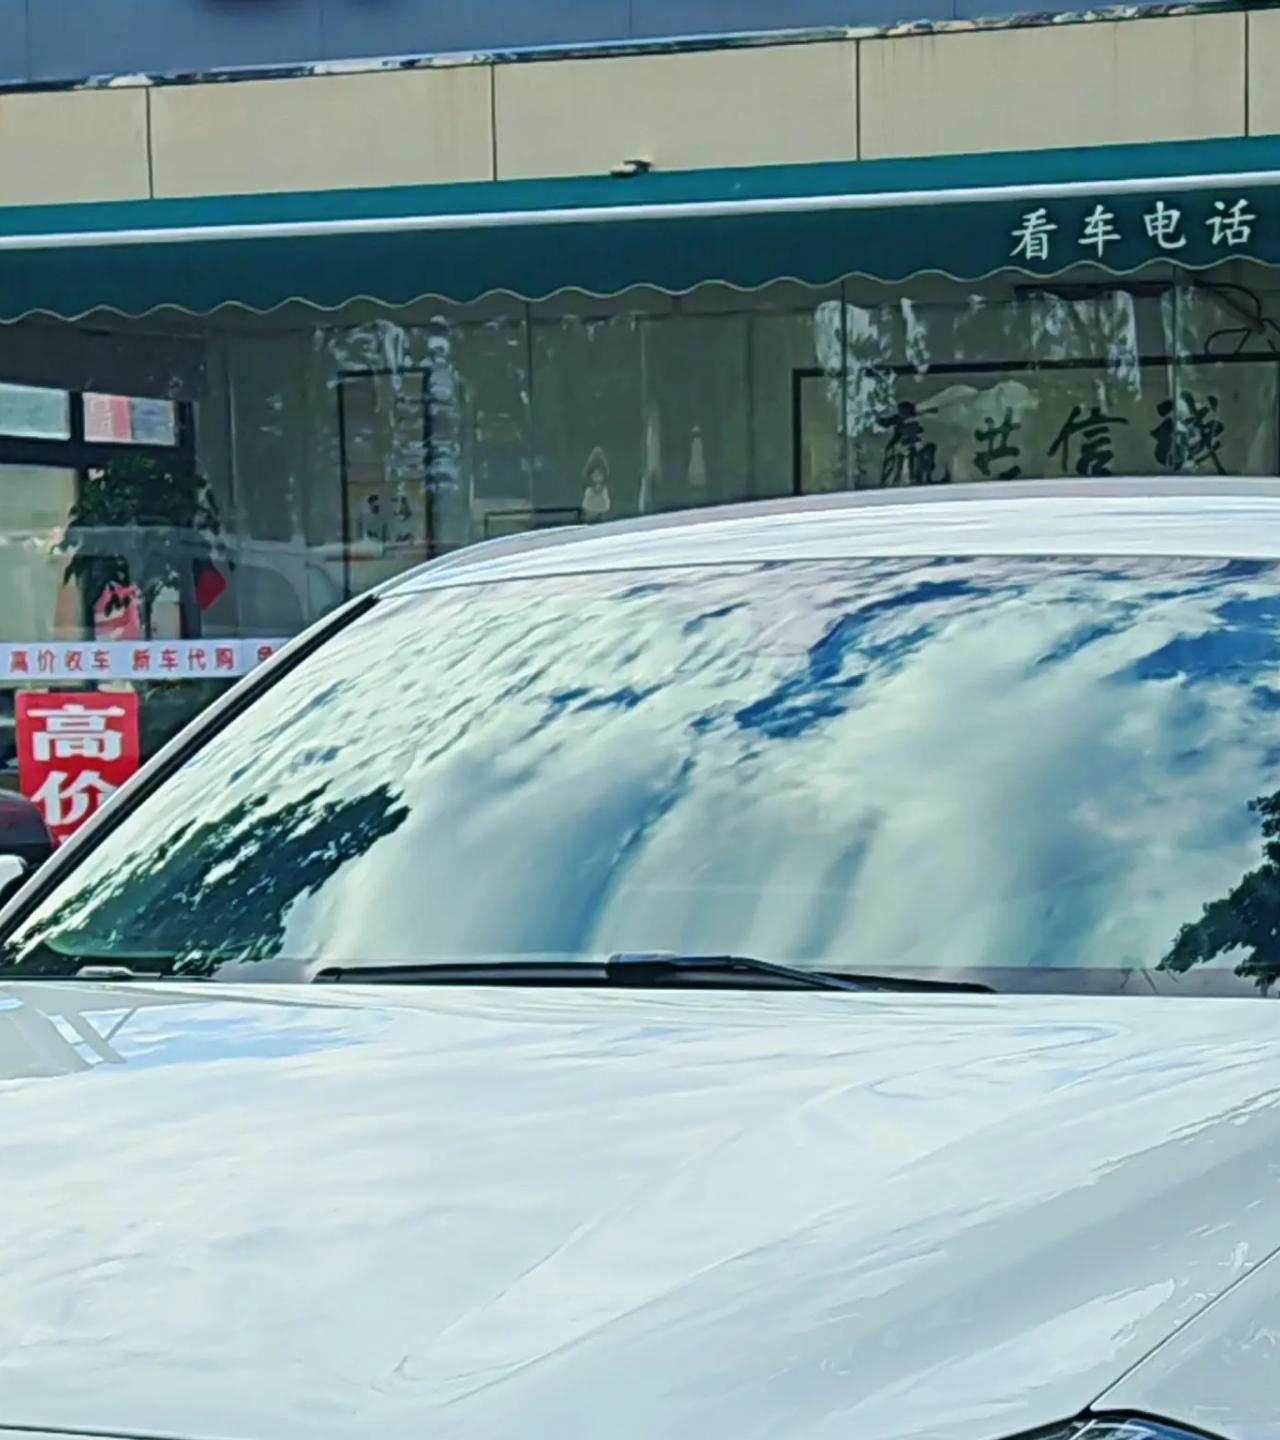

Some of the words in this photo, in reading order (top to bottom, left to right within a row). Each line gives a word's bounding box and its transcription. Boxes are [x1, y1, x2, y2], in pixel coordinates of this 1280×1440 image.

[1008, 199, 1257, 261] 看车电话
[10, 649, 111, 673] 高价收车
[27, 703, 126, 843] 高价
